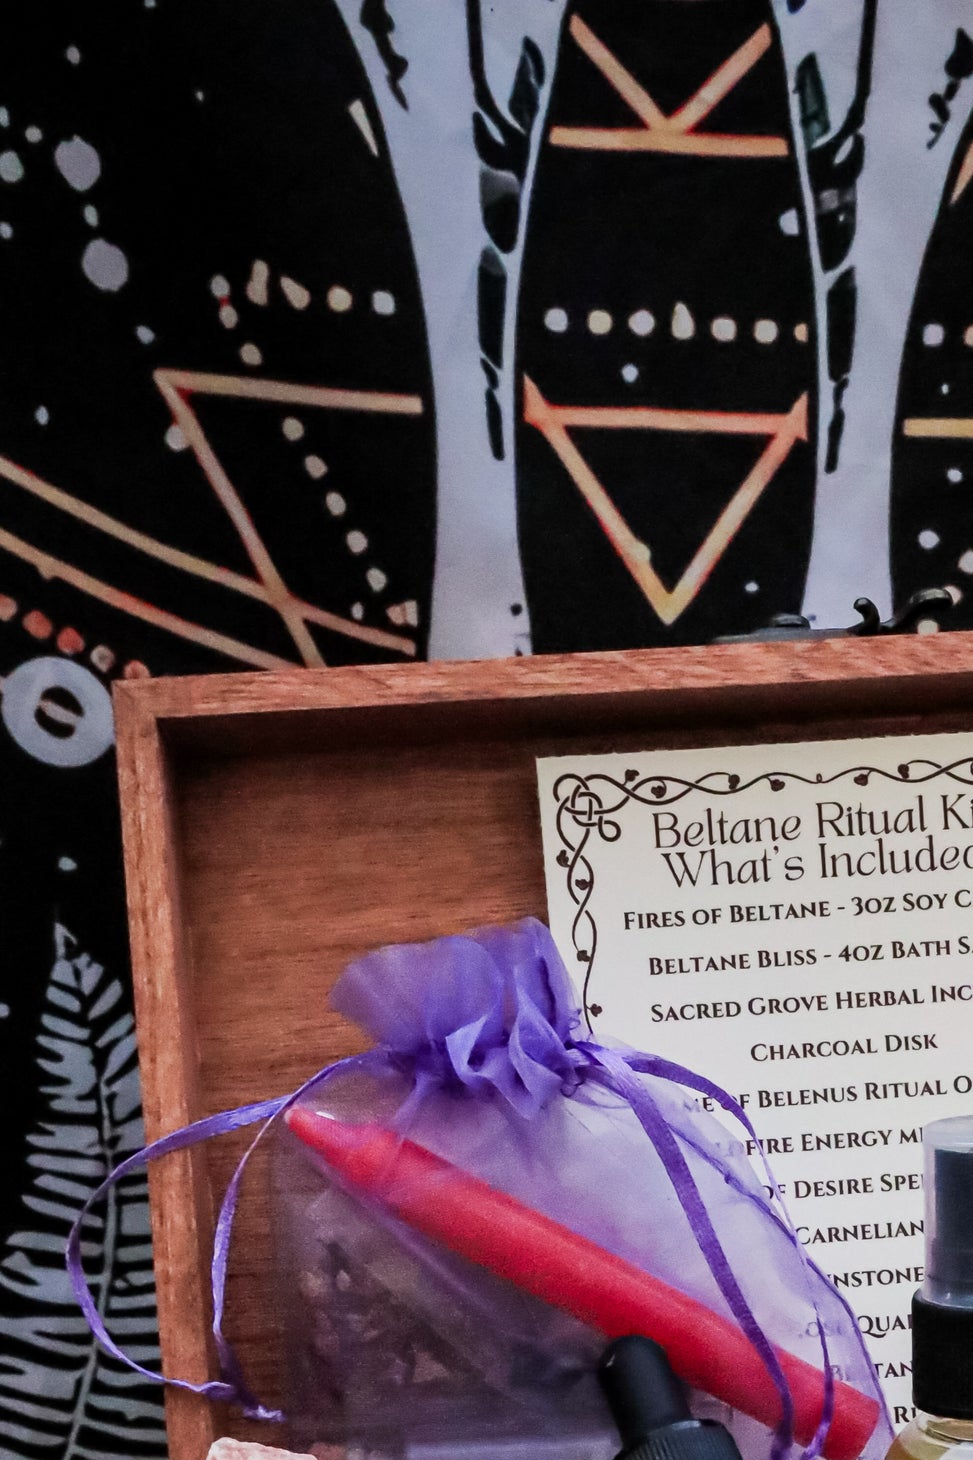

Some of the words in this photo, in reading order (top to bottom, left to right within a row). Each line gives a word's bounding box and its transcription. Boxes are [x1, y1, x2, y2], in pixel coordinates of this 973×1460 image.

[652, 808, 801, 848] Beltane
[816, 795, 927, 838] Ritual
[661, 845, 805, 888] What's
